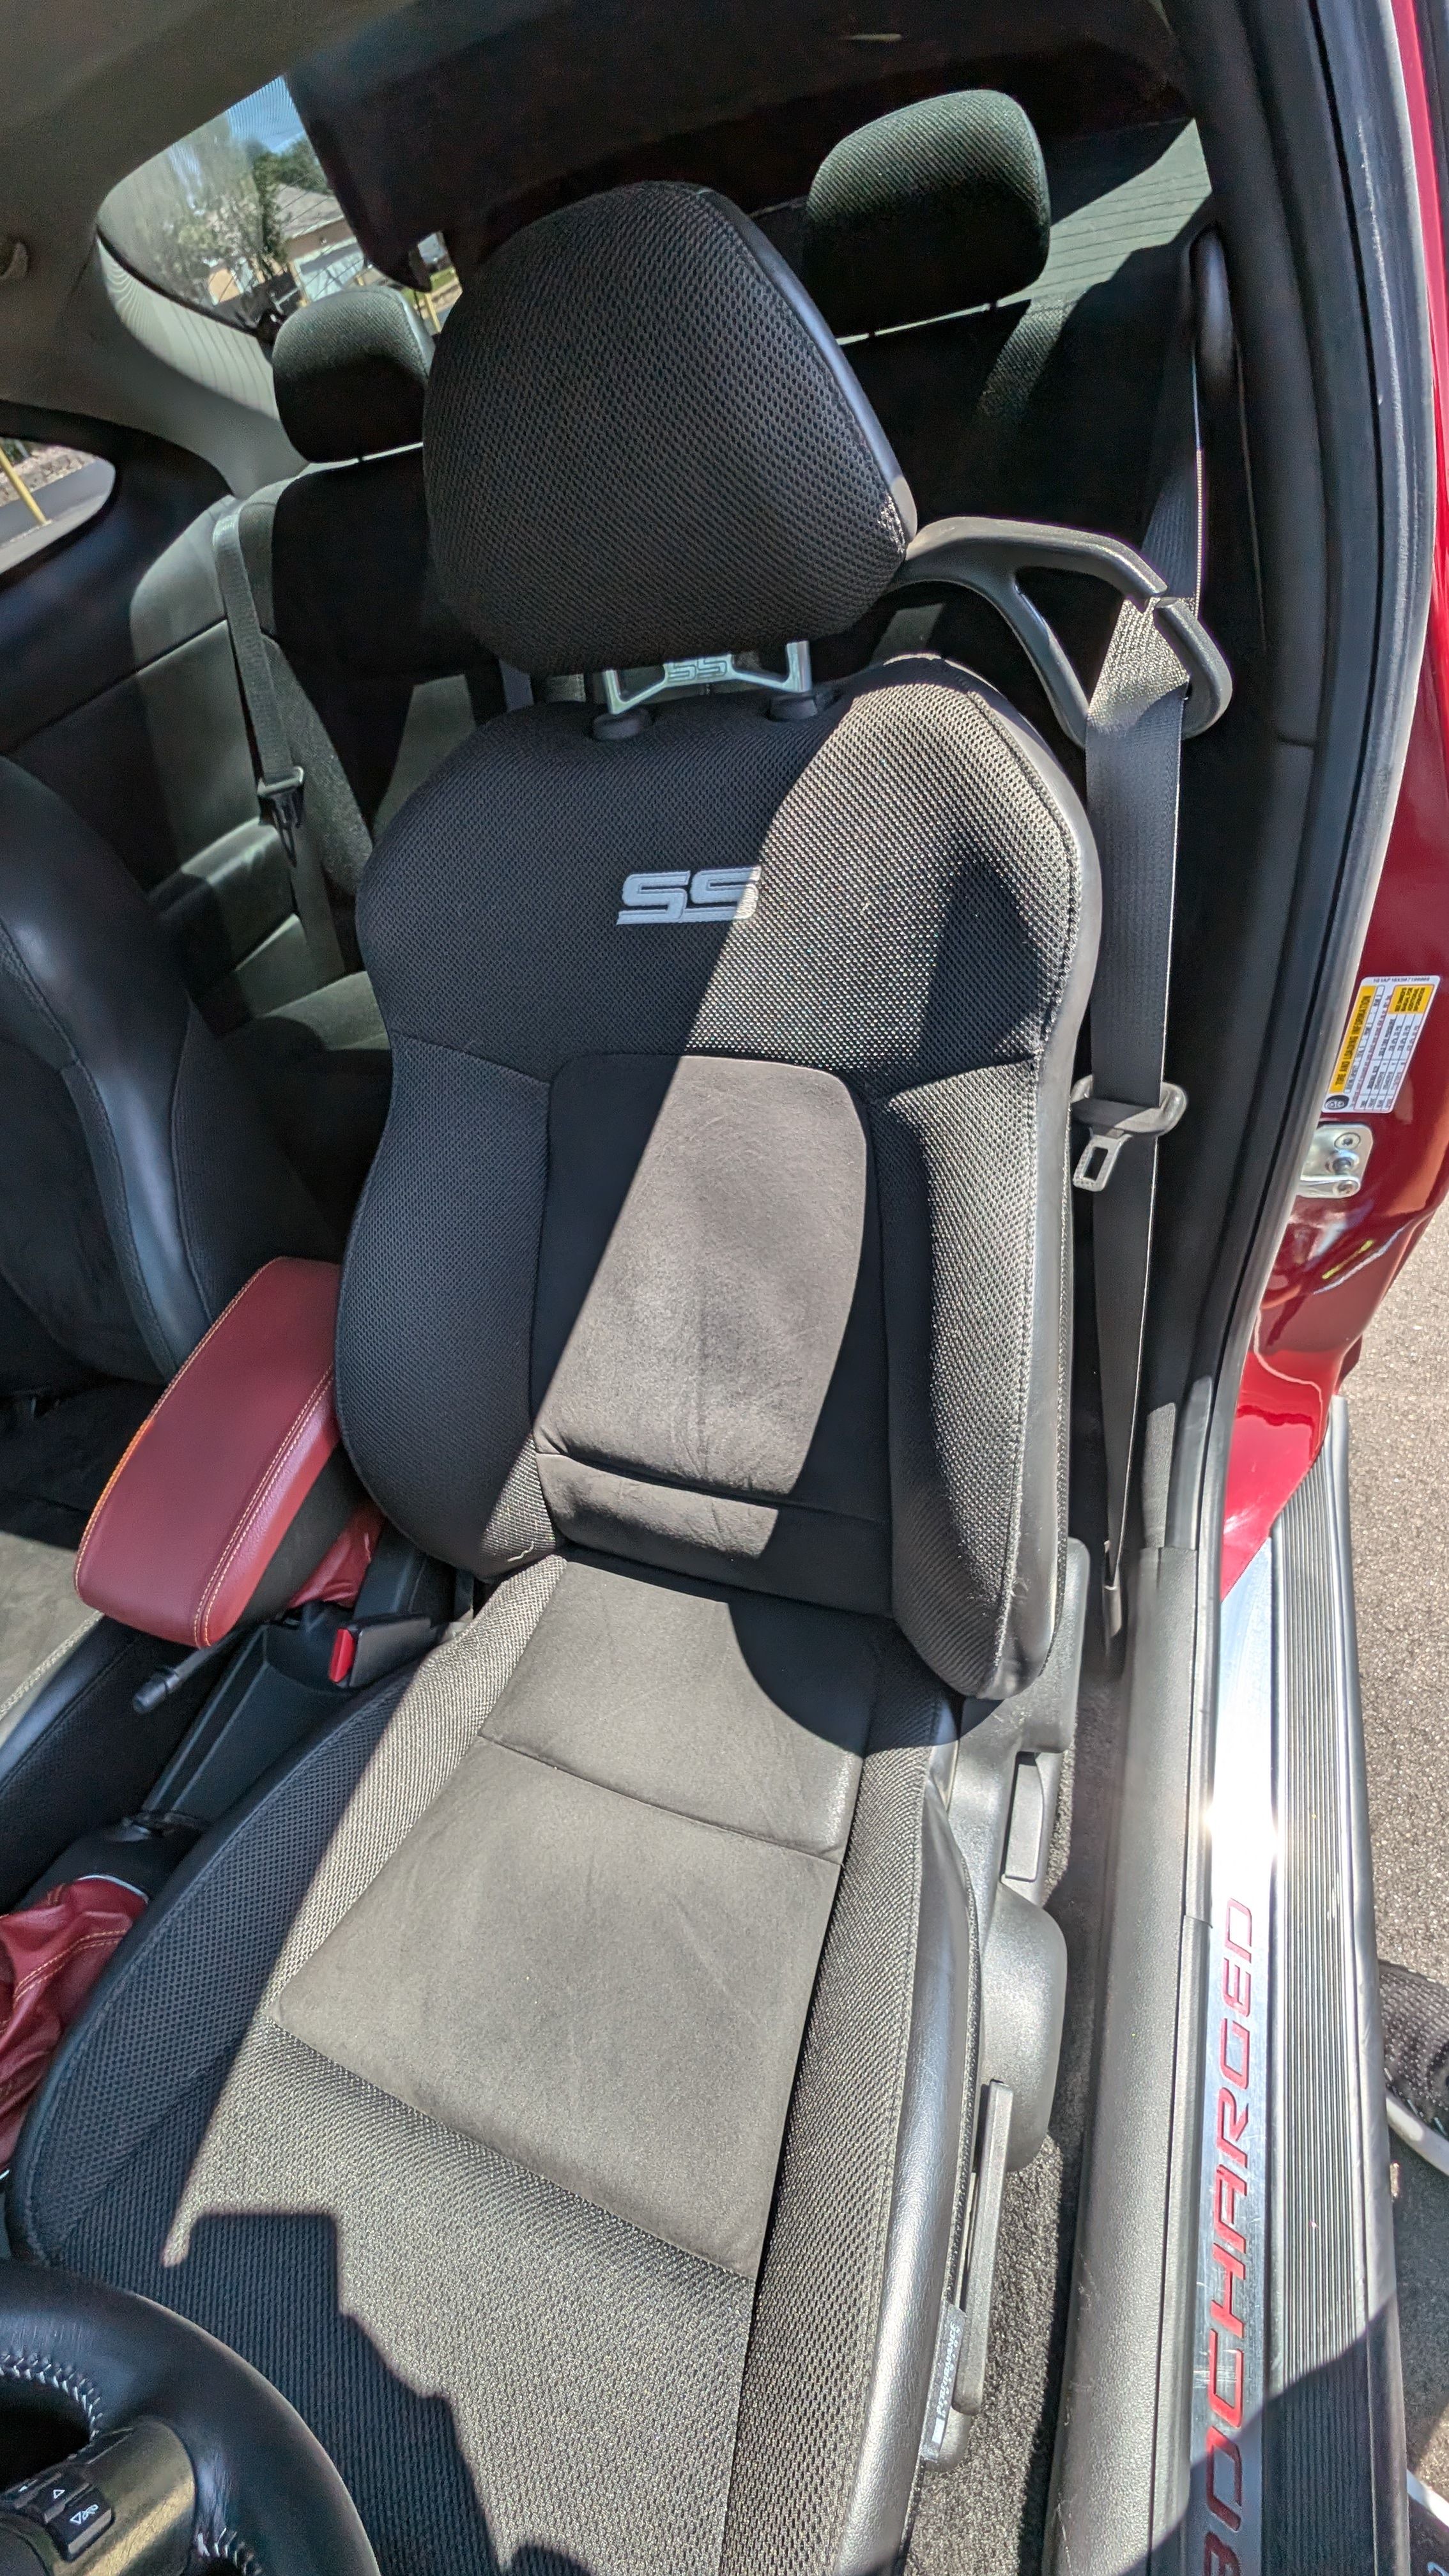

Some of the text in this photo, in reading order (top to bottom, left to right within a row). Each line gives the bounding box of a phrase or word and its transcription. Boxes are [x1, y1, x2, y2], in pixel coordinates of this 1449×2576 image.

[617, 865, 762, 926] SS
[1352, 995, 1372, 1035] INFORMATION
[1343, 1036, 1359, 1060] LOADING
[1335, 1073, 1347, 1085] TIRE
[1340, 1061, 1351, 1072] AND
[936, 2321, 957, 2416] PERFORMANCE
